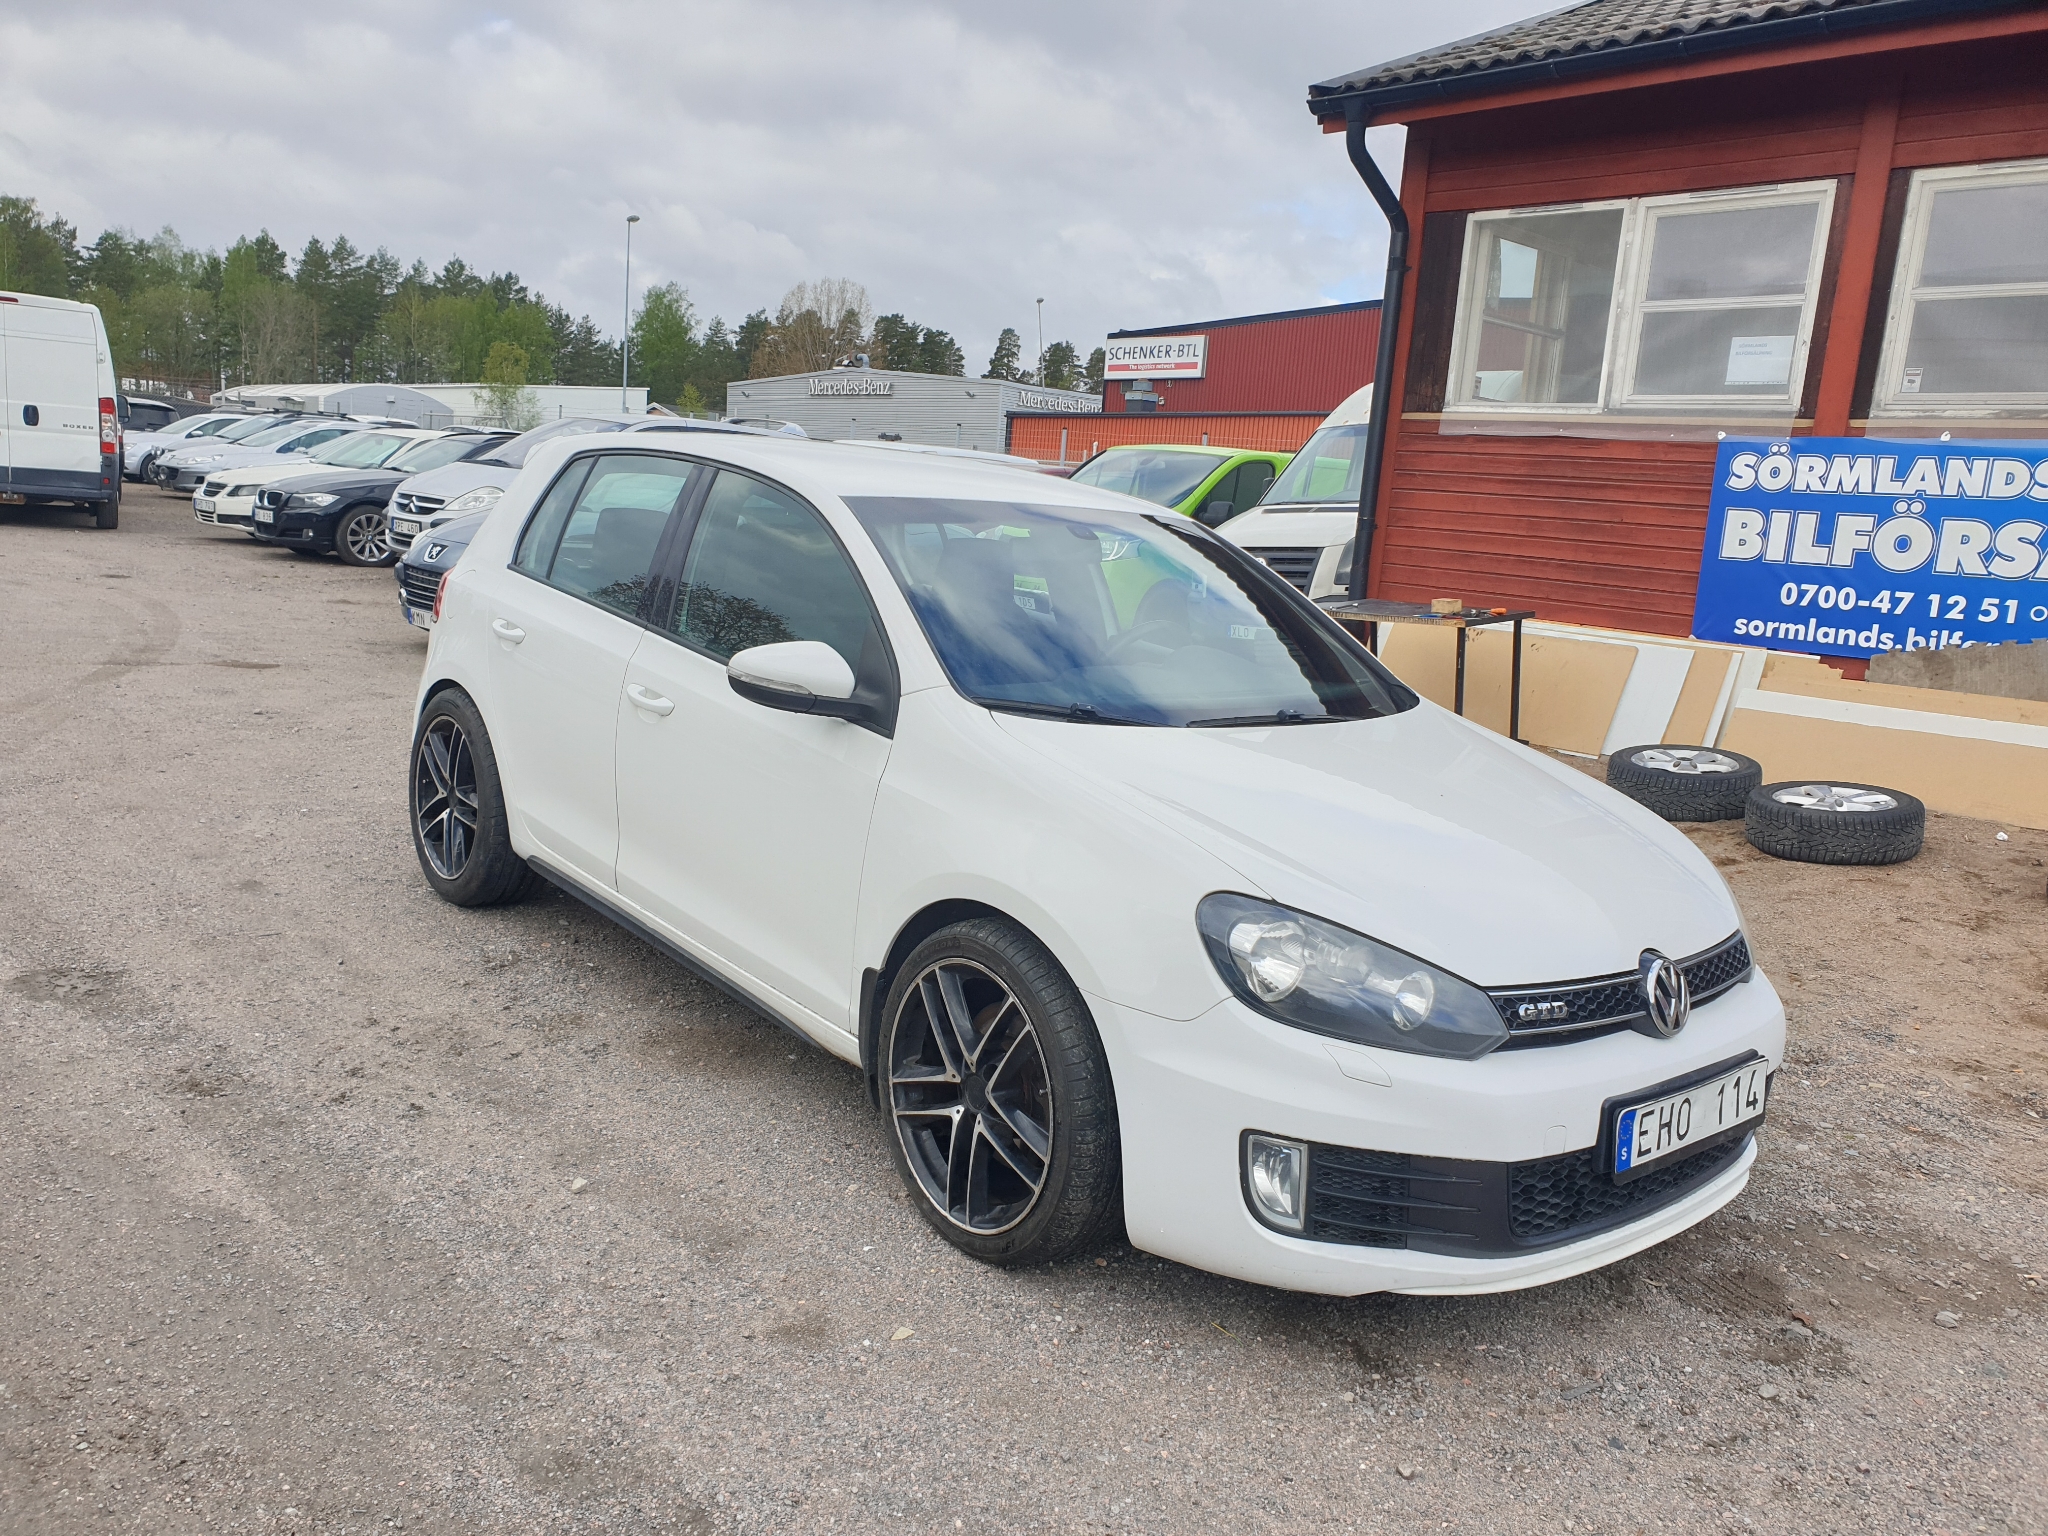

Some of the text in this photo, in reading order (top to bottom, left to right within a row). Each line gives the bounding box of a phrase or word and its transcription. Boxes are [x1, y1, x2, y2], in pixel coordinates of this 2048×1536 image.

[1108, 343, 1200, 361] SCHENKER-BTL
[808, 377, 891, 395] Mercedes-Benz
[1725, 442, 2048, 502] SÖRMLANDS
[407, 523, 419, 534] 460
[1780, 582, 2019, 624] 0700-47 12 51
[1518, 1001, 1569, 1021] GTD
[1636, 1069, 1759, 1159] EHO 114
